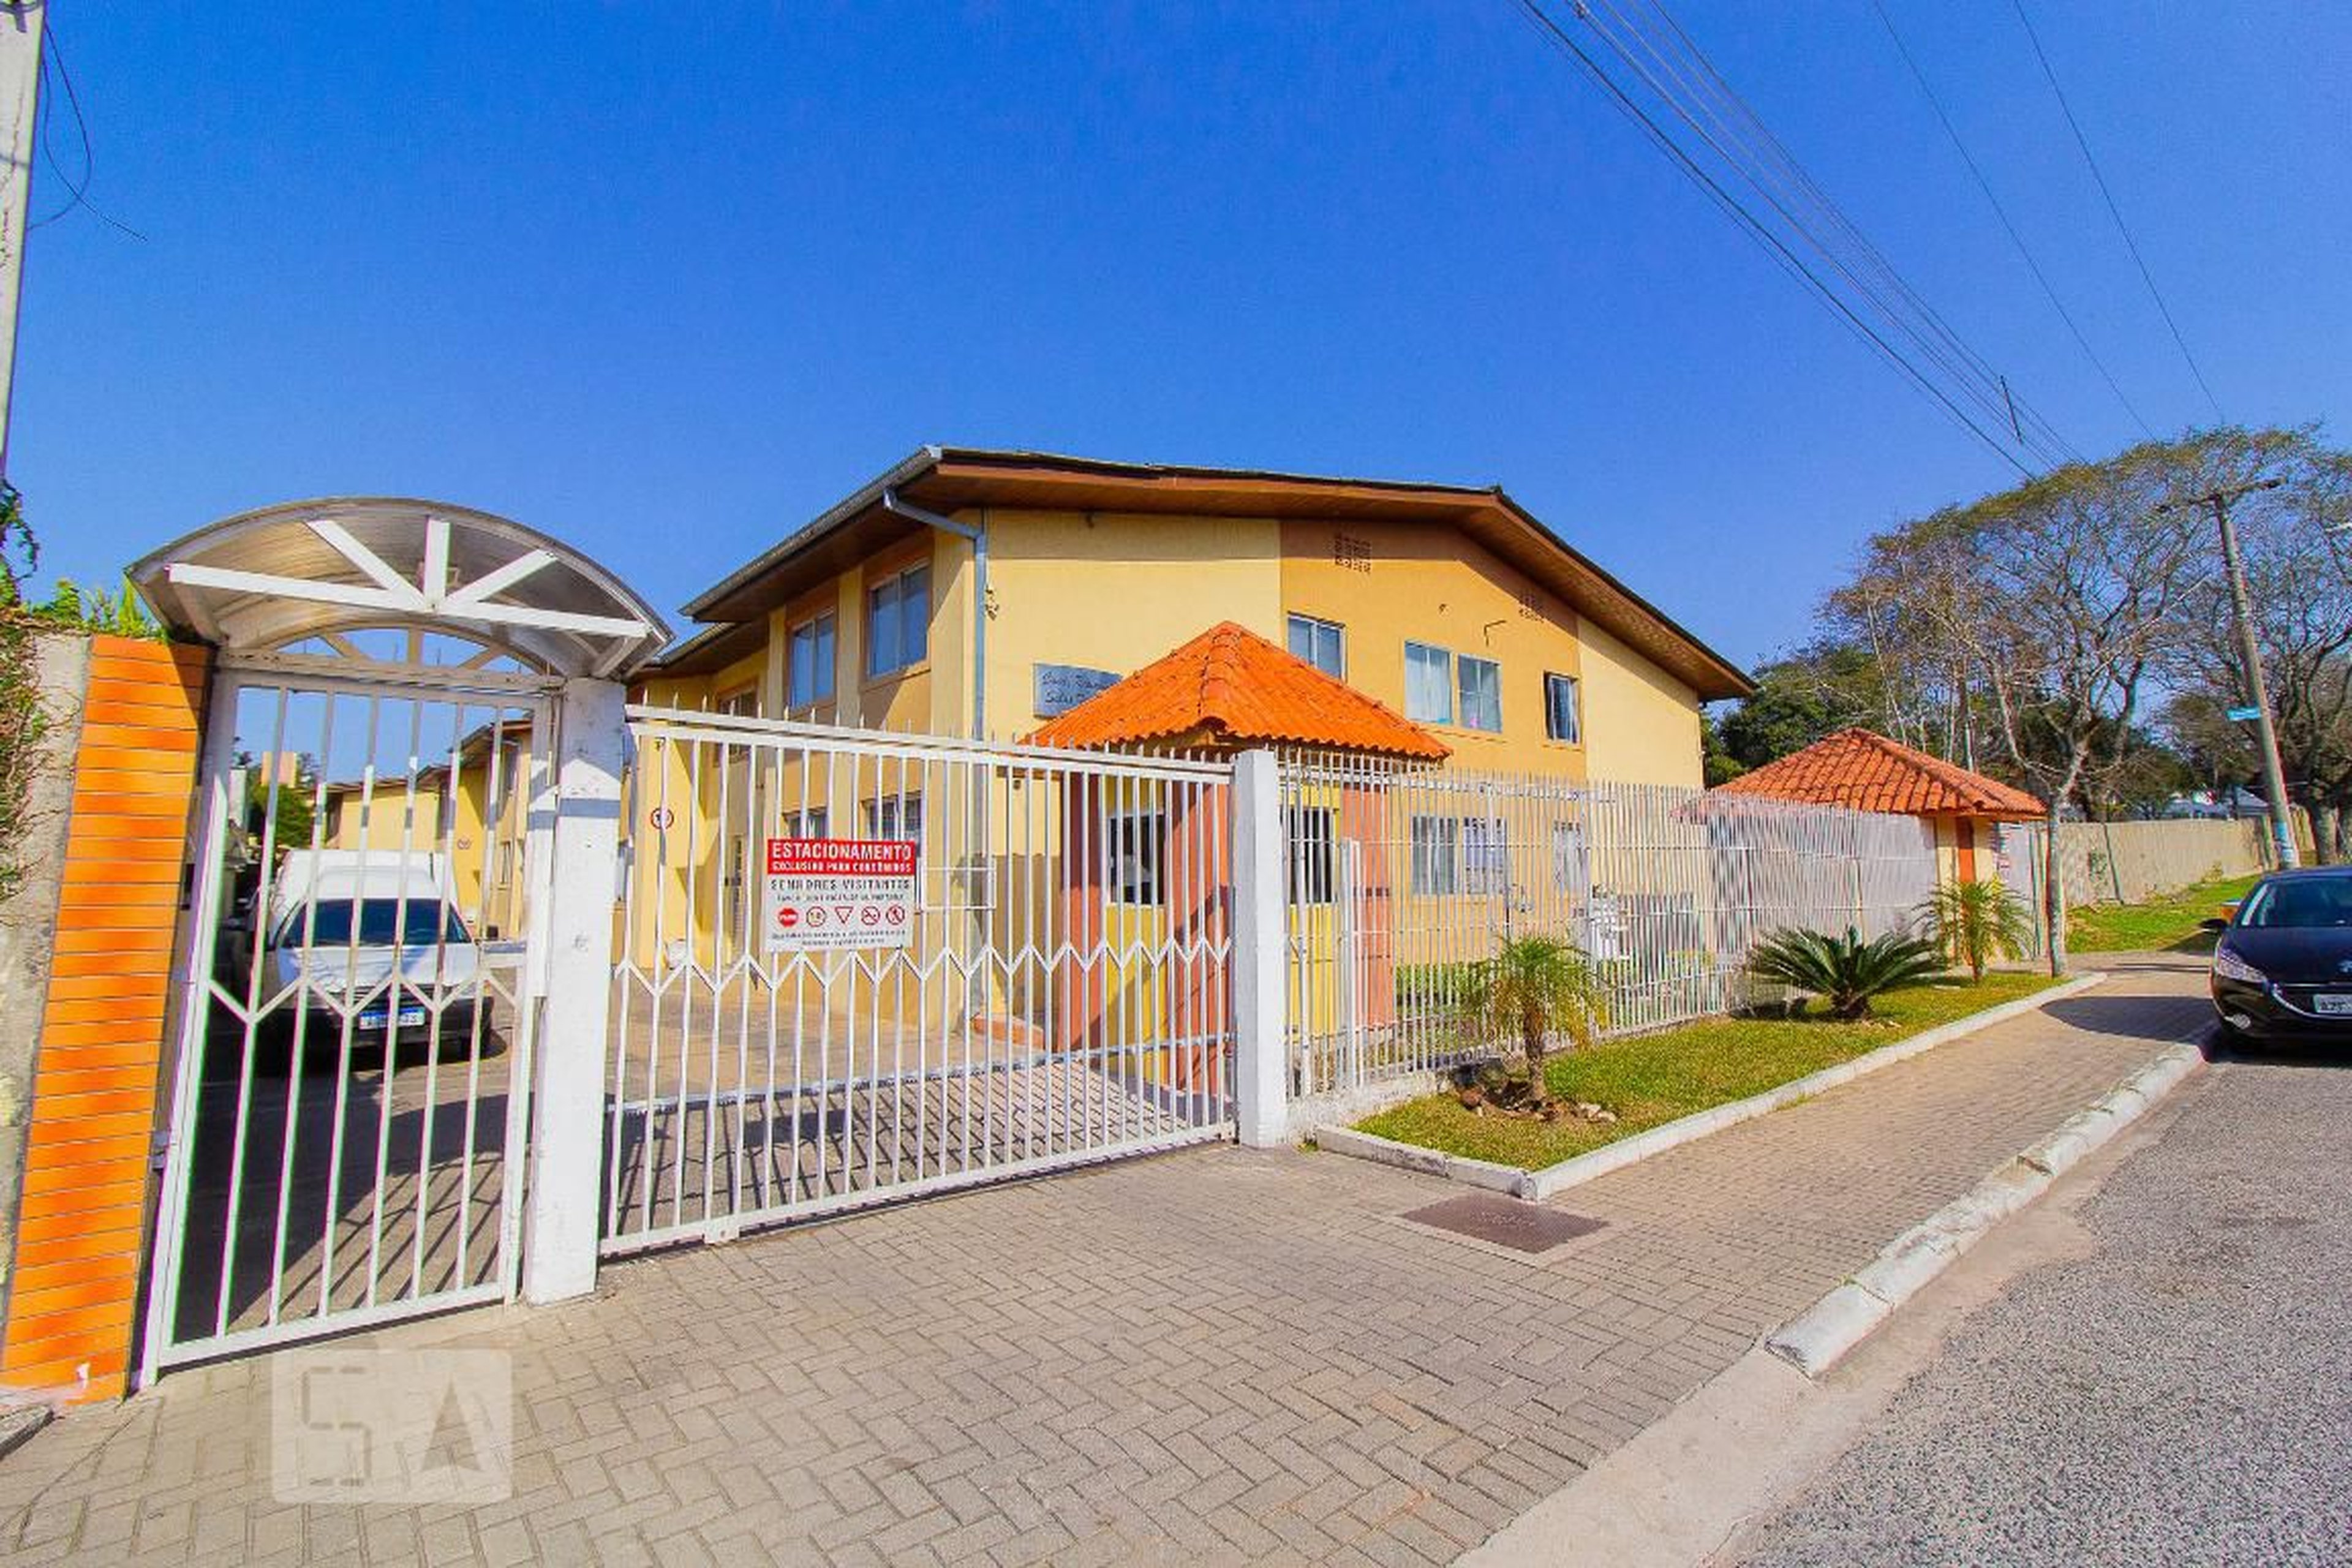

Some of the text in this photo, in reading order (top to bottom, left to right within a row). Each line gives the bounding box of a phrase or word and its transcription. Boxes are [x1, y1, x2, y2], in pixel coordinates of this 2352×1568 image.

[772, 842, 911, 860] ESTACIONAMENTO
[771, 880, 910, 890] SENHORES VISITANTES
